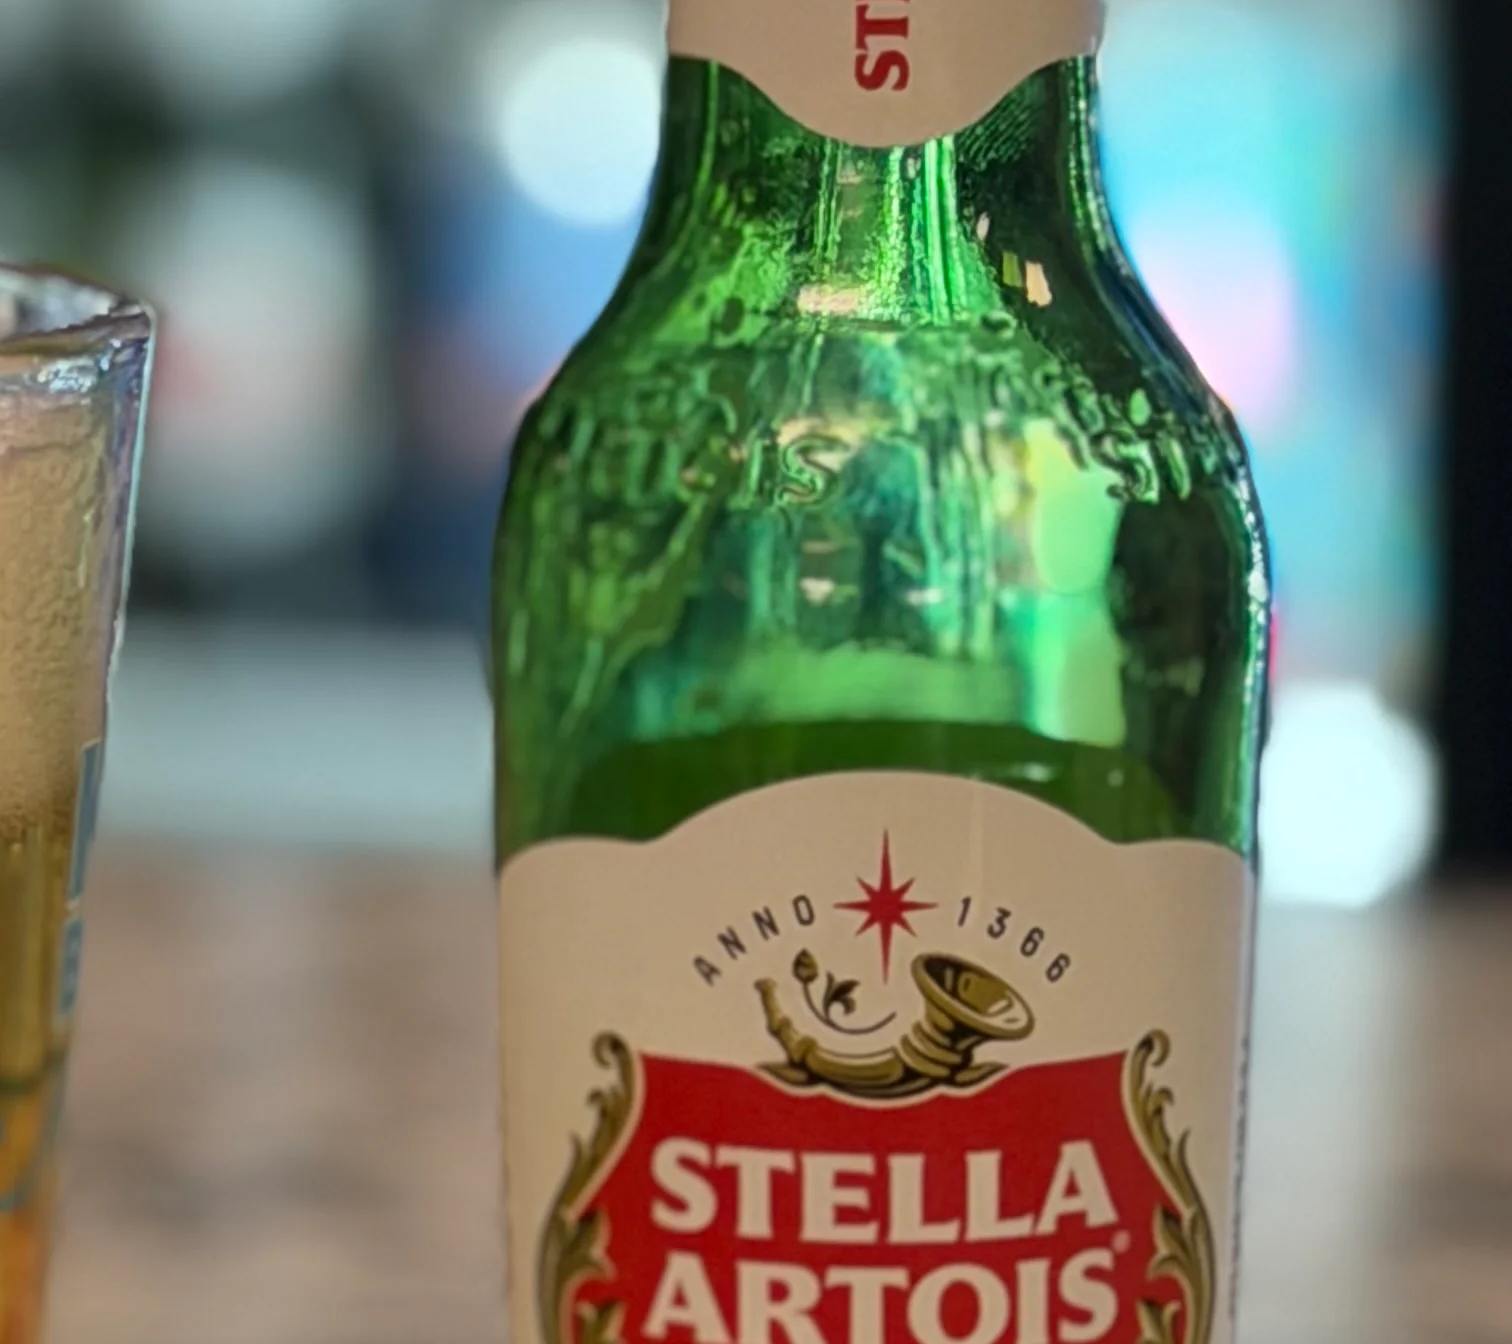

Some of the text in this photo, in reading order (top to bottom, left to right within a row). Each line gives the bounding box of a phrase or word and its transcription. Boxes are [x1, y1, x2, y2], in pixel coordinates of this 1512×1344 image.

[692, 894, 1072, 988] ANNO 1366
[648, 1134, 1121, 1246] STELLA
